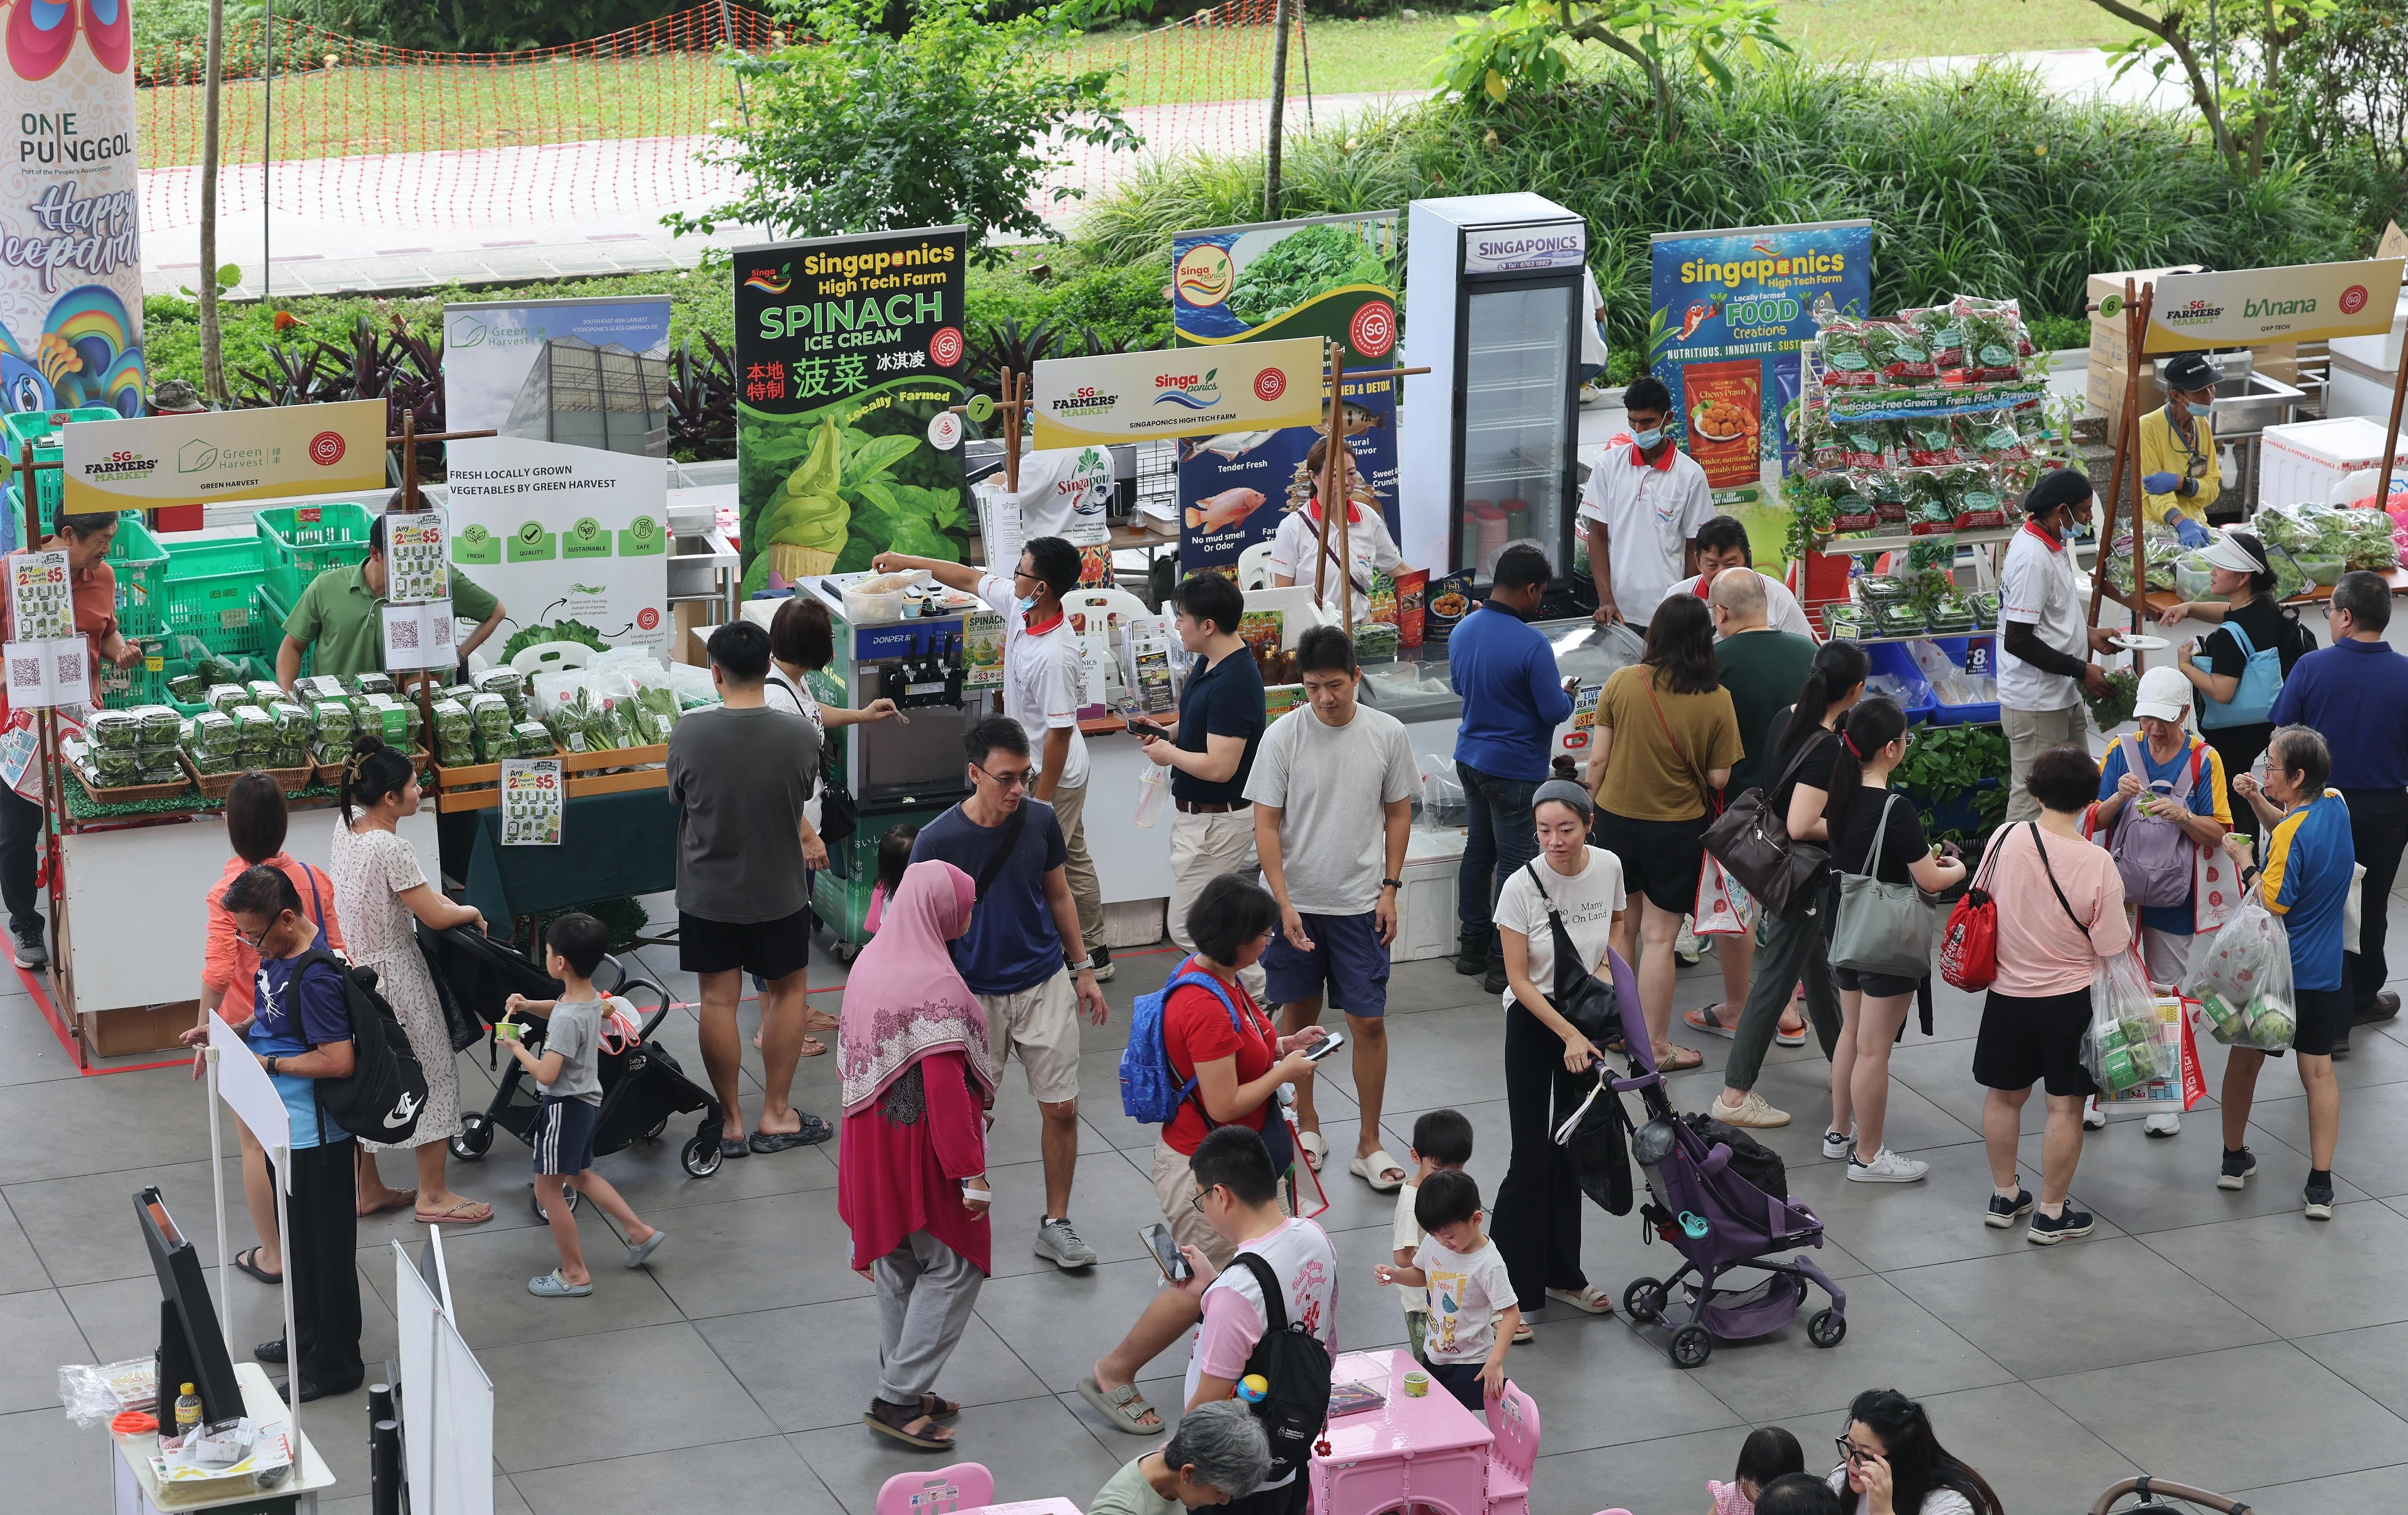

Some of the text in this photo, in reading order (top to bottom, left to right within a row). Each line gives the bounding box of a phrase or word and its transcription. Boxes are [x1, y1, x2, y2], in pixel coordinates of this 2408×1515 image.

[22, 113, 77, 135] ONE
[20, 132, 131, 163] PUNGGOL
[81, 165, 111, 173] Association
[31, 181, 135, 236] Happy
[1479, 236, 1577, 256] SINGAPONICS
[1551, 249, 1574, 258] farm
[751, 268, 776, 277] Singa
[1181, 266, 1209, 276] Singa
[819, 271, 946, 298] High Tech Farm
[1768, 274, 1842, 289] High Tech Farm
[1735, 293, 1758, 302] Locally
[2107, 301, 2115, 311] 6
[2190, 300, 2205, 309] SG
[760, 291, 942, 339] SPINACH
[1726, 298, 1799, 326] FOOD
[2167, 308, 2224, 320] FARMERS'
[492, 327, 527, 336] Green
[1367, 322, 1384, 335] SG
[1733, 325, 1787, 339] Creations
[489, 336, 529, 346] Harvest
[805, 328, 901, 351] ICE CREAM
[941, 342, 954, 352] SG
[1668, 342, 1775, 359] NUTRITIOUS. INNOVATIVE.
[876, 350, 925, 371] 冰淇凌
[746, 361, 784, 381] 本地
[793, 352, 869, 399] 菠菜
[1155, 374, 1198, 390] Singa
[1264, 380, 1277, 389] SG
[1366, 380, 1390, 394] DETOX
[746, 379, 784, 401] 特制
[1077, 387, 1095, 397] SG
[1186, 382, 1218, 395] ponics
[1700, 390, 1723, 399] Chewy
[846, 391, 950, 422] Locally Farmed
[1053, 395, 1118, 410] FARMERS'
[1832, 401, 1902, 411] Pesticide-Free
[1904, 399, 1938, 408] Greens
[1946, 396, 1971, 405] Fresh
[1974, 393, 1997, 402] Fish,
[977, 403, 985, 414] 7
[1130, 413, 1237, 429] SINGAPONICS HIGH TECH FARM
[2026, 418, 2037, 430] 2
[223, 448, 262, 458] Green
[319, 444, 335, 453] SG
[1695, 444, 1715, 453] Delicious!
[112, 451, 131, 462] SG
[1722, 455, 1750, 463] nutritious
[85, 459, 158, 474] FARMERS'
[219, 458, 263, 469] Harvest
[1218, 460, 1268, 473] Tender Fresh
[450, 465, 572, 480] FRESH LOCALLY GROWN
[1373, 469, 1394, 478] Sweet
[225, 479, 259, 488] HARVEST
[450, 479, 616, 495] VEGETABLES BY GREEN HARVEST
[1373, 477, 1399, 487] Crunchy
[395, 533, 404, 545] 2
[422, 528, 440, 544] $5
[1206, 534, 1223, 542] mud
[1224, 530, 1245, 541] smell
[1215, 542, 1234, 552] Odor
[18, 573, 29, 585] 2
[47, 566, 63, 583] $5
[1444, 582, 1460, 590] Fish
[873, 635, 904, 644] DONPER
[1974, 648, 1986, 665] 8
[829, 667, 845, 690] Cream
[1584, 691, 1599, 699] LIVE
[1577, 700, 1587, 708] SEA
[509, 777, 518, 789] 2
[536, 775, 554, 789] $5
[1581, 901, 1603, 912] Many
[1572, 910, 1607, 923] On Land
[1432, 1256, 1443, 1269] BEEP!
[1292, 1260, 1323, 1290] Hello Kitty
[1295, 1274, 1326, 1306] Dear Daniel
[1437, 1282, 1453, 1292] BEEP!
